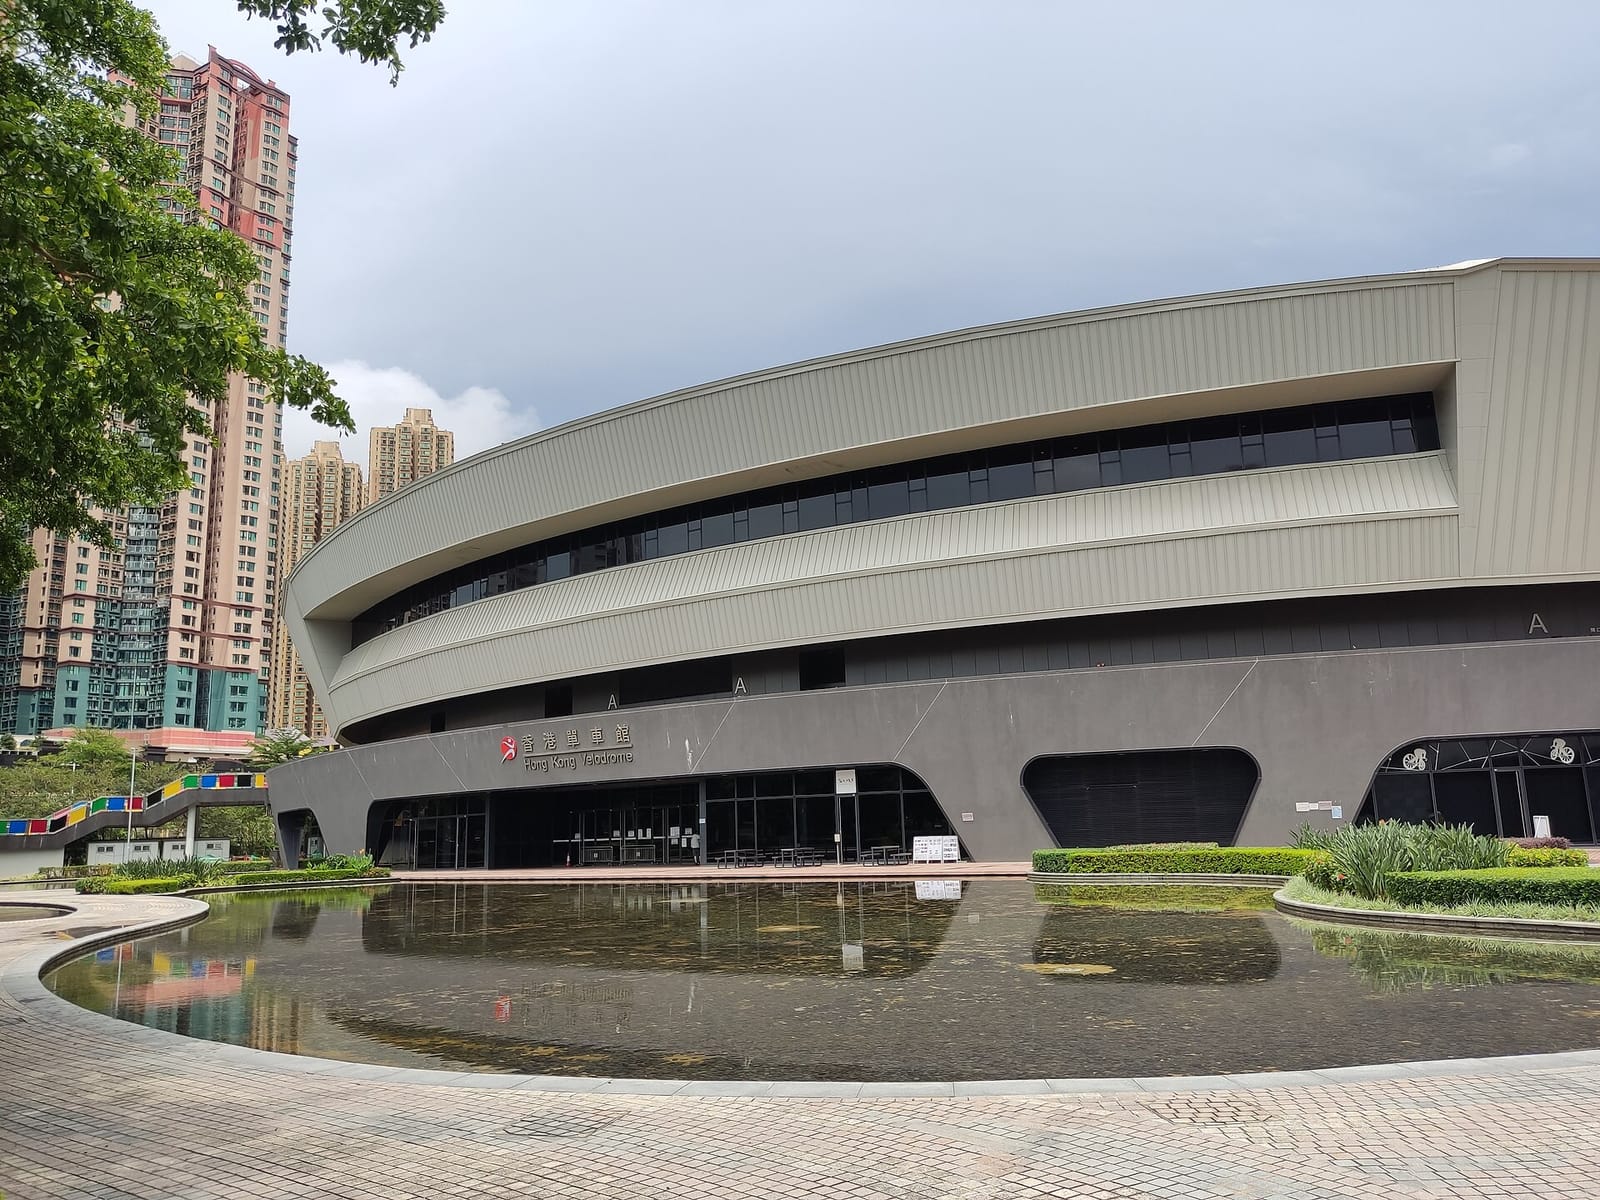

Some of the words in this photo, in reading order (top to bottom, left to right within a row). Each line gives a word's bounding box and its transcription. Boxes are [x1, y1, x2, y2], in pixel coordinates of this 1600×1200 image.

[1528, 613, 1549, 634] A
[734, 677, 747, 694] A
[607, 694, 618, 710] A
[521, 723, 631, 753] 香港單車館
[523, 758, 548, 773] Hong
[551, 755, 577, 770] Kong
[582, 751, 634, 767] Velodrome
